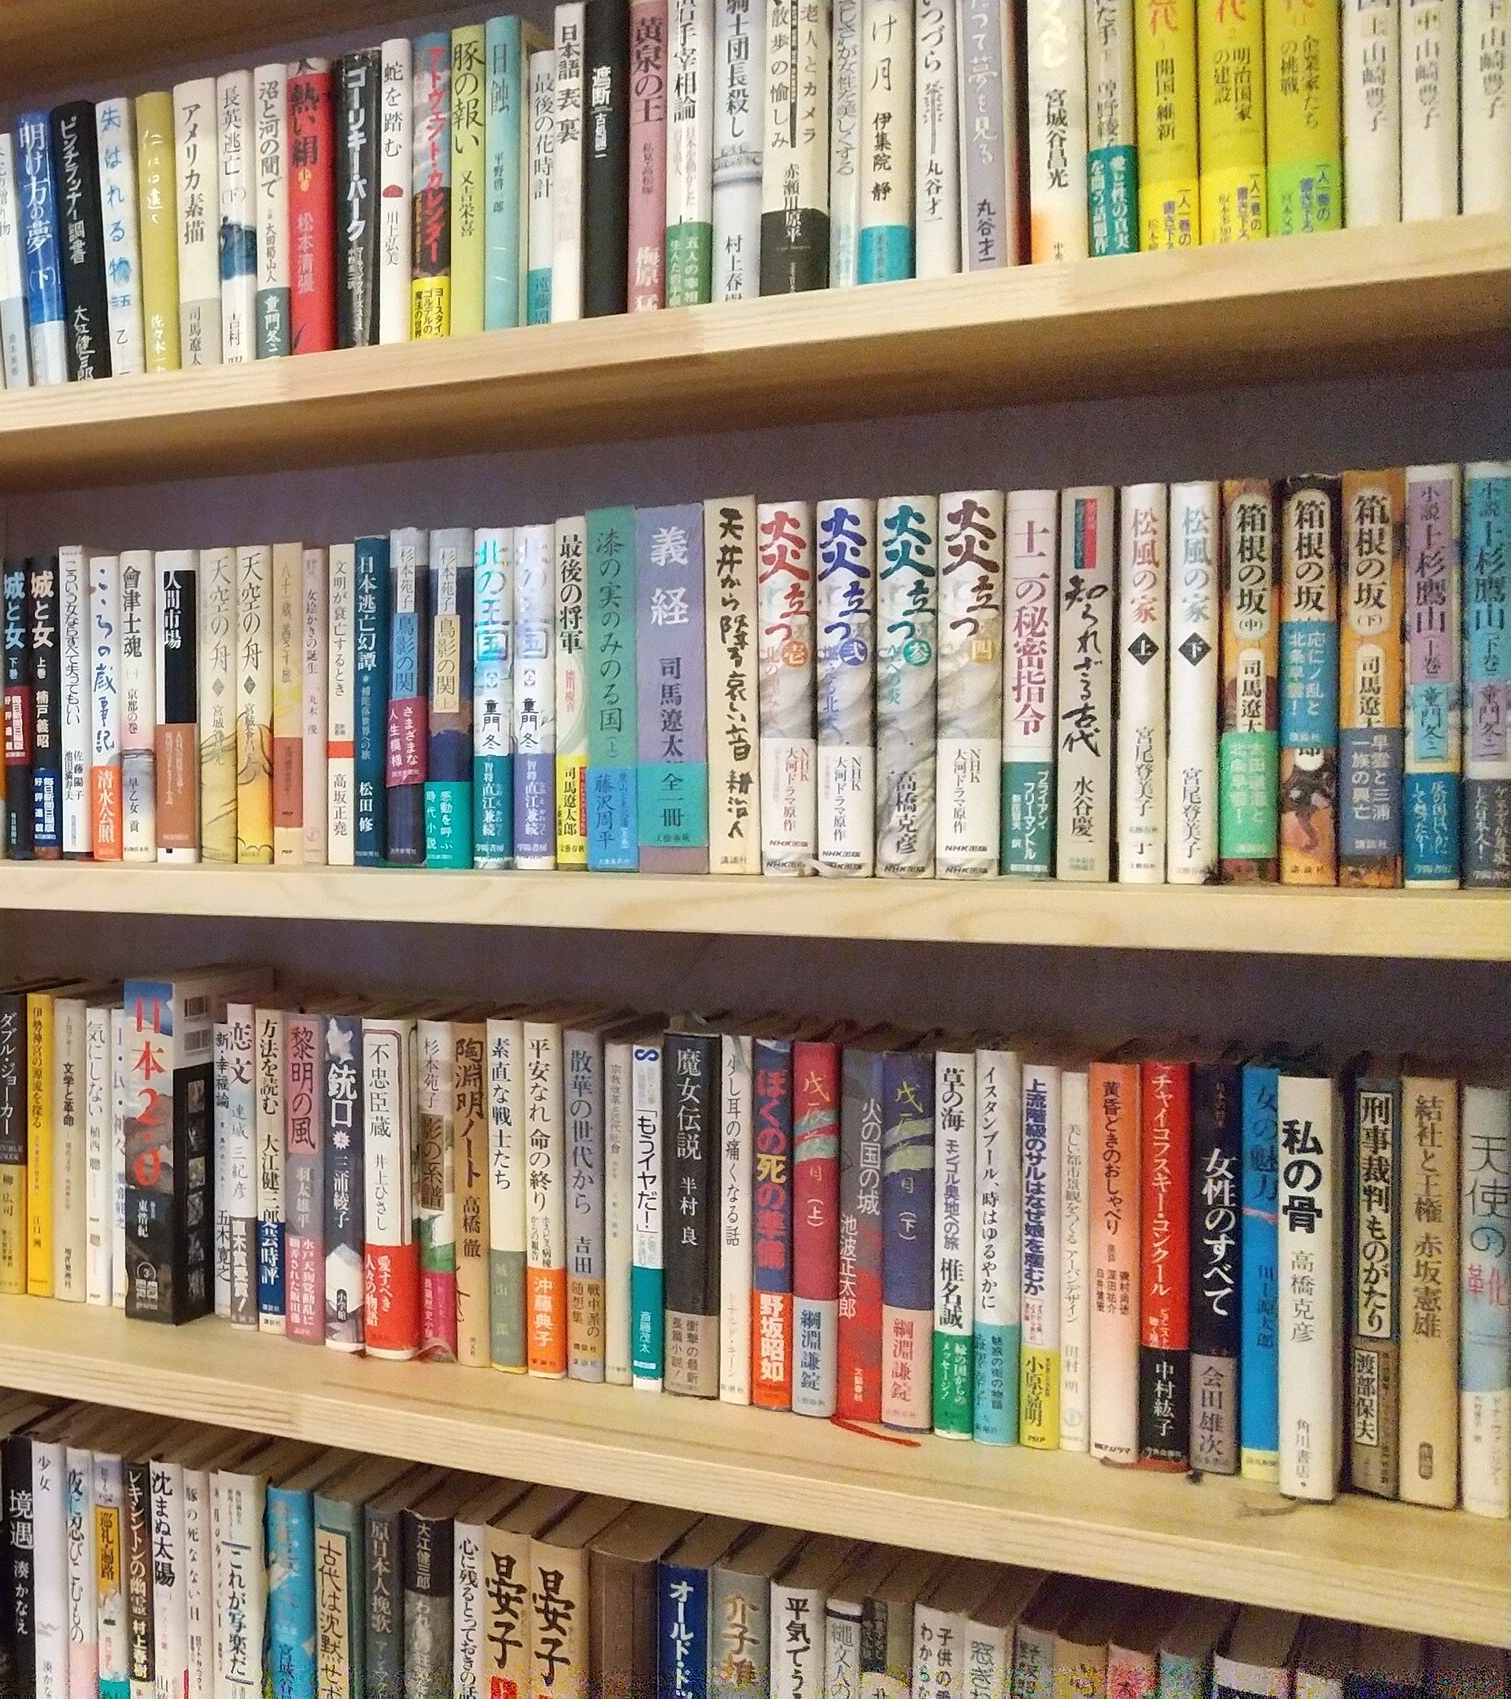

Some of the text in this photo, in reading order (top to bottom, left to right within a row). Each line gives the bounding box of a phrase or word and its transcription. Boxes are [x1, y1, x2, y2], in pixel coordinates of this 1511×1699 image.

[383, 62, 404, 158] 蛇を踏む
[454, 44, 483, 154] 豚の報い
[491, 44, 509, 116] 日蝕
[634, 17, 663, 125] 黄泉の王
[801, 5, 819, 144] 老人とカメラ
[1156, 58, 1175, 141] 開国・維新
[1233, 48, 1252, 121] 明治国家
[182, 103, 204, 245] アメリカ素描
[222, 86, 241, 175] 長英逃亡
[259, 81, 280, 198] 沼と河の間で
[290, 82, 319, 168] 熱い絹
[347, 66, 366, 241] ゴーリキー・パーク
[534, 73, 554, 200] 最後の花時計
[1045, 88, 1068, 189] 宮城谷昌光
[60, 116, 86, 265] ピンチランナー調書
[459, 170, 475, 238] 又吉栄喜
[494, 152, 505, 213] 平野啓一郎
[783, 164, 802, 242] 赤瀬川原平
[296, 215, 315, 294] 松本清張
[385, 211, 399, 266] 川上弘美
[400, 549, 414, 609] 杉本苑子
[560, 534, 583, 654] 最後の将軍
[651, 526, 689, 626] 義経
[758, 510, 811, 642] 炎立つ
[818, 508, 871, 642] 炎立つ
[881, 506, 935, 637] 炎立つ
[942, 500, 1000, 637] 炎立つ
[1131, 506, 1159, 624] 松風の家
[1181, 506, 1212, 624] 松風の家
[1235, 503, 1267, 614] 箱根の坂
[1293, 499, 1325, 612] 箱根の坂
[1354, 496, 1388, 609] 箱根の坂
[5, 570, 25, 649] 城と女
[31, 570, 55, 649] 城と女
[123, 566, 141, 658] 會津士魂
[242, 552, 262, 672] 天空の舟
[333, 561, 346, 697] 文明が衰亡するとき
[357, 557, 377, 670] 日本逃亡幻譚
[596, 528, 624, 732] 漆の実のみのる国
[1012, 520, 1051, 735] 十二の秘密指令
[127, 689, 138, 734] 京都の巻
[1062, 575, 1108, 757] 知られざる古代
[390, 710, 402, 767] 人生模様
[405, 706, 418, 766] さまざまな
[1135, 726, 1155, 818] 宮尾登美子
[360, 782, 373, 833] 松田修
[564, 767, 577, 837] 司馬遼太郎
[660, 773, 684, 827] 全一冊
[783, 748, 798, 831] 大河ドラマ原作
[834, 756, 847, 841] 大河ドラマ原作
[953, 748, 967, 833] 大河ドラマ原作
[1182, 768, 1203, 859] 宮尾登美子
[0, 1013, 17, 1135] ダブル・ジョーカー
[62, 1063, 74, 1126] 文学と革命
[260, 1019, 278, 1114] 方法を読む
[290, 1026, 316, 1149] 黎明の風
[328, 1062, 357, 1128] 銃口
[369, 1044, 390, 1139] 不忠臣蔵
[456, 1038, 483, 1187] 陶淵明ノート
[491, 1037, 512, 1191] 素直な戦士たち
[677, 1050, 701, 1160] 魔女伝説
[942, 1067, 966, 1130] 草の海
[570, 1050, 595, 1215] 散華の世代から
[726, 1056, 741, 1247] 少し耳の痛くなる話
[857, 1099, 882, 1216] 火の国の城
[1102, 1082, 1121, 1237] 黄昏どきのおしゃべり
[1282, 1119, 1322, 1234] 私の骨
[1414, 1095, 1443, 1223] 結社と王権
[373, 1155, 388, 1231] 井上ひさし
[681, 1177, 697, 1246] 半村良
[1024, 1079, 1046, 1295] 上流階級のサルはなぜ娘を産むか
[1151, 1076, 1173, 1295] チャイコフスキー・コンクール
[1203, 1148, 1238, 1316] 女性のすべて
[1362, 1095, 1389, 1333] 刑事裁判ものがたり
[1465, 1135, 1509, 1260] 天使の
[378, 1255, 391, 1313] 愛すべき
[534, 1278, 553, 1347] 沖藤典子
[840, 1214, 857, 1319] 池波正太郎
[939, 1258, 964, 1329] 椎名誠
[1413, 1234, 1442, 1338] 赤坂憲雄
[759, 1295, 784, 1382] 野坂昭如
[1154, 1361, 1174, 1436] 中村紘子
[1295, 1420, 1310, 1480] 角川書店
[10, 1490, 33, 1550] 境遇
[38, 1455, 51, 1492] 少女
[153, 1471, 176, 1587] 沈まぬ太陽
[186, 1488, 199, 1621] 豚の死なない日
[371, 1522, 391, 1634] 原日本人挽歌
[14, 1560, 28, 1634] 湊かなえ
[133, 1620, 147, 1678] 村上春樹
[229, 1551, 246, 1675] これが写楽だ
[486, 1552, 526, 1670] 晏子
[532, 1568, 574, 1687] 晏子
